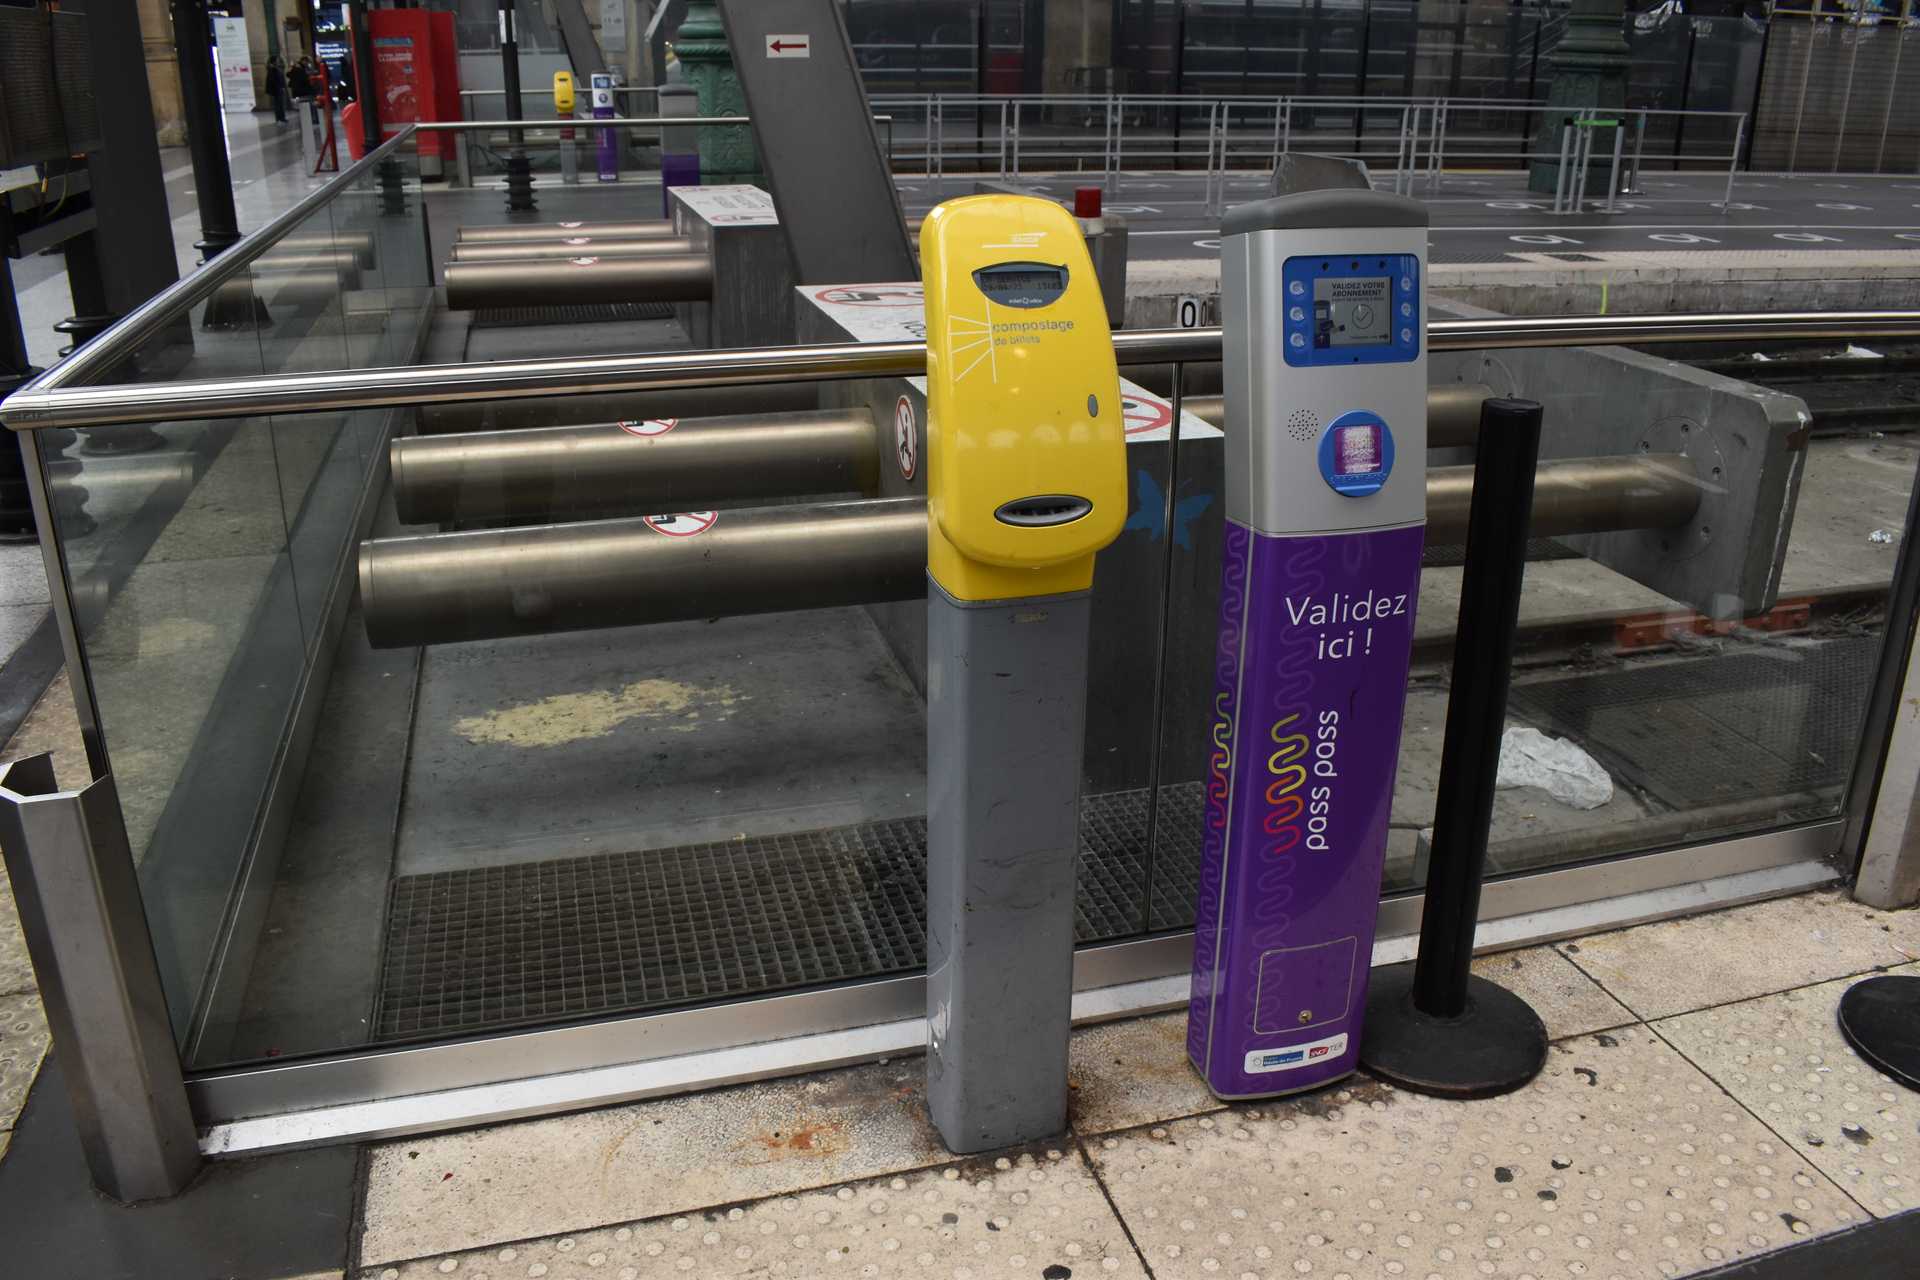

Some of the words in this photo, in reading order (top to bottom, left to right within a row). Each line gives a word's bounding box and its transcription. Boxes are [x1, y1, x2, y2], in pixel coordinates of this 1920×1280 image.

[1331, 281, 1361, 290] VALIDEZ
[1362, 281, 1385, 289] VOTRE
[1332, 289, 1382, 297] ABONNEMENT
[992, 319, 1075, 334] compostage
[994, 337, 1008, 347] de
[1009, 335, 1041, 345] billets
[1285, 588, 1408, 626] Validez
[1318, 630, 1355, 661] ici
[1313, 709, 1340, 778] pass
[1305, 785, 1331, 851] pass
